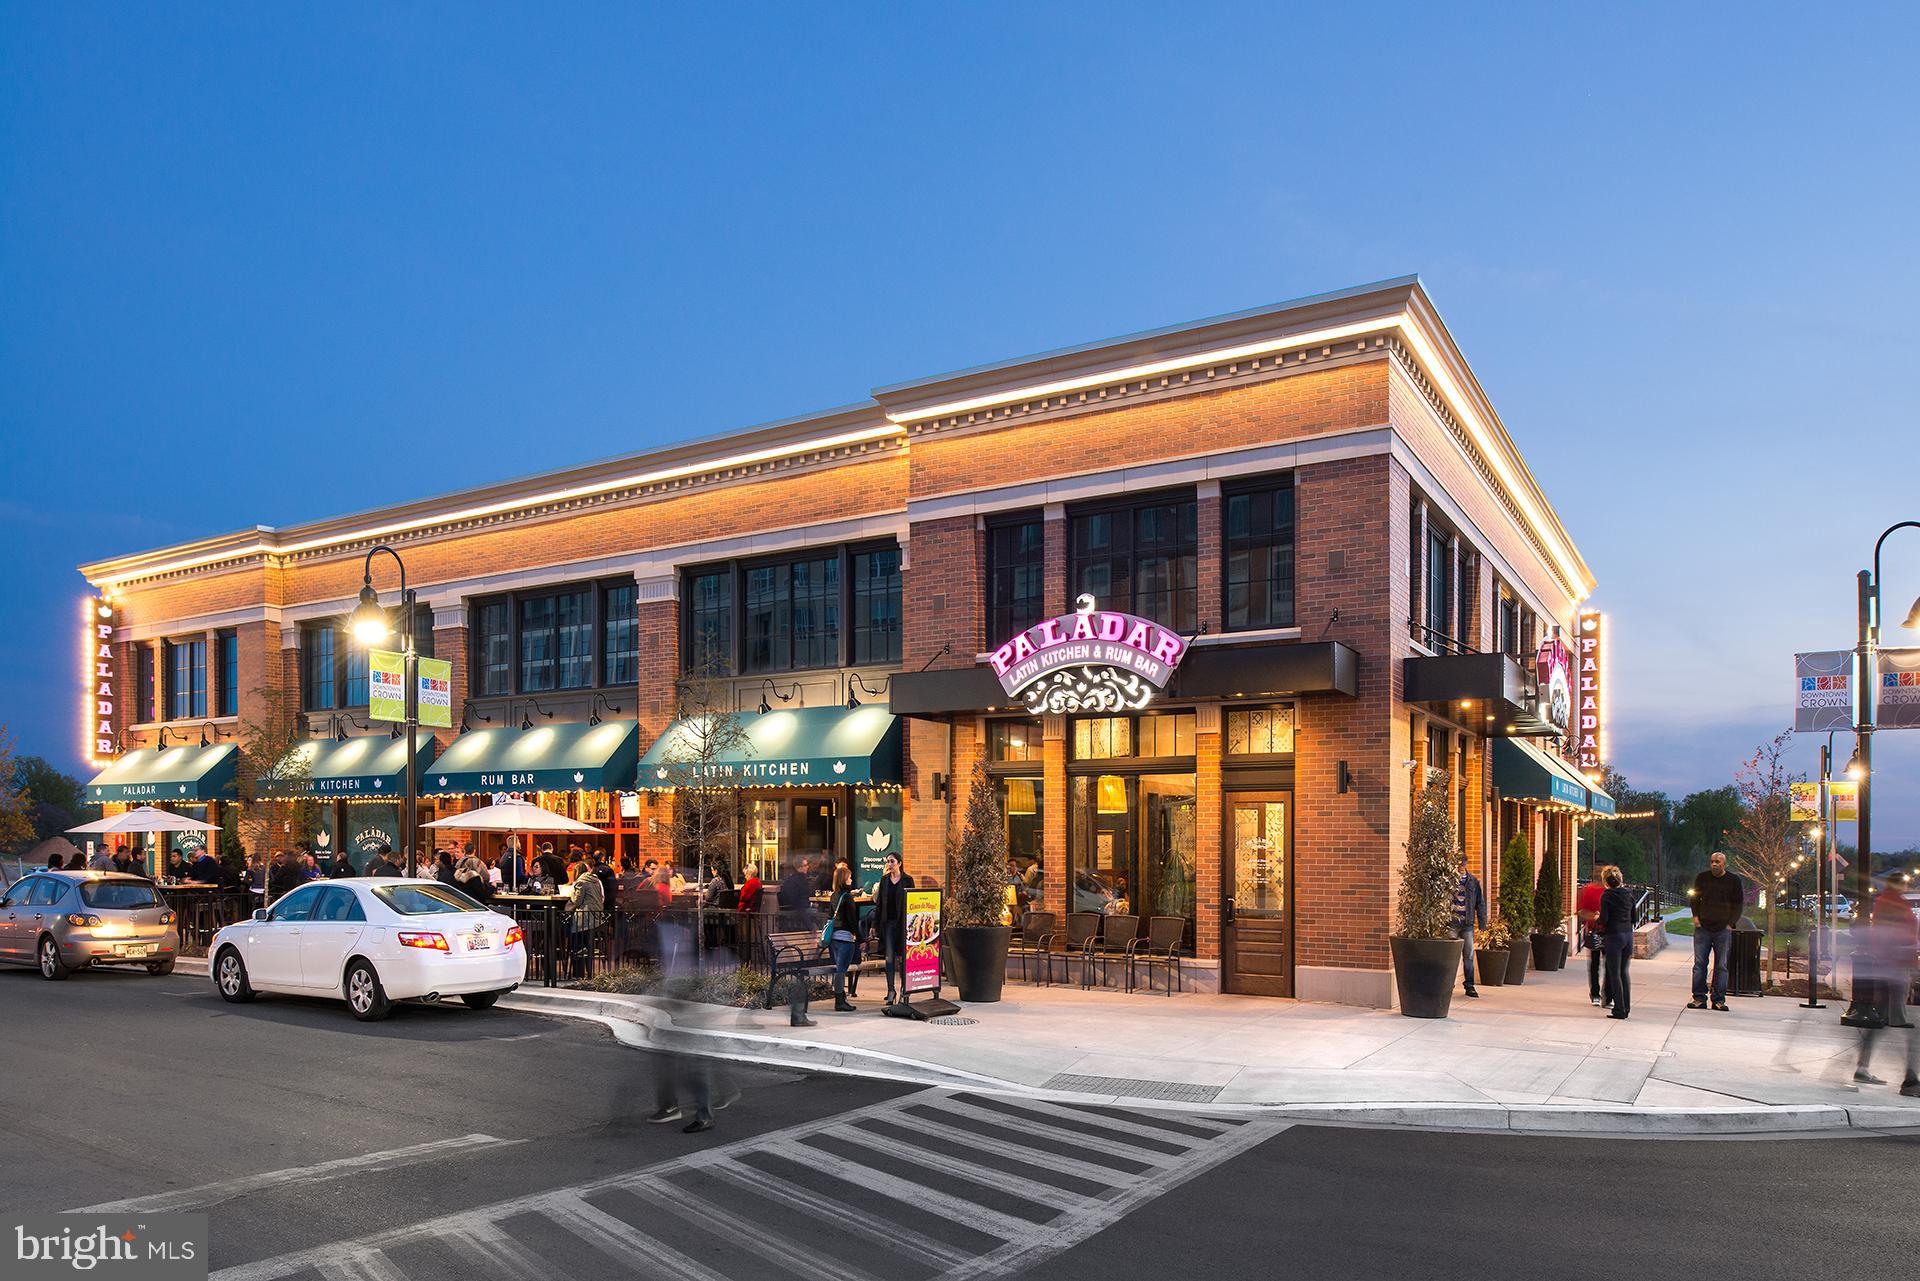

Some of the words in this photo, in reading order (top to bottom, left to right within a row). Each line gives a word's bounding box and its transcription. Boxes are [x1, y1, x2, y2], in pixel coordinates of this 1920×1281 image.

[989, 612, 1182, 675] PALADAR
[1009, 659, 1038, 686] LATIN
[1041, 644, 1090, 668] KITCHEN
[1093, 645, 1102, 658] &
[1105, 646, 1133, 664] RUM
[1135, 656, 1159, 678] BAR
[97, 624, 113, 753] PALADAR
[1882, 687, 1920, 695] DOWNTO
[372, 690, 401, 700] CROWN
[421, 690, 448, 699] DOWNTOWN
[1801, 691, 1848, 699] DOWNTOWN
[1882, 695, 1920, 705] CROW
[421, 696, 448, 706] CROWN
[1581, 638, 1598, 768] PALADAR
[1801, 697, 1848, 708] CROWN
[692, 764, 733, 778] LATIN
[743, 762, 810, 777] KITCHEN
[320, 779, 360, 790] KITCHEN
[481, 774, 504, 786] RUM
[511, 773, 535, 785] BAR
[123, 785, 156, 795] PALADAR
[355, 830, 392, 845] PALADAR
